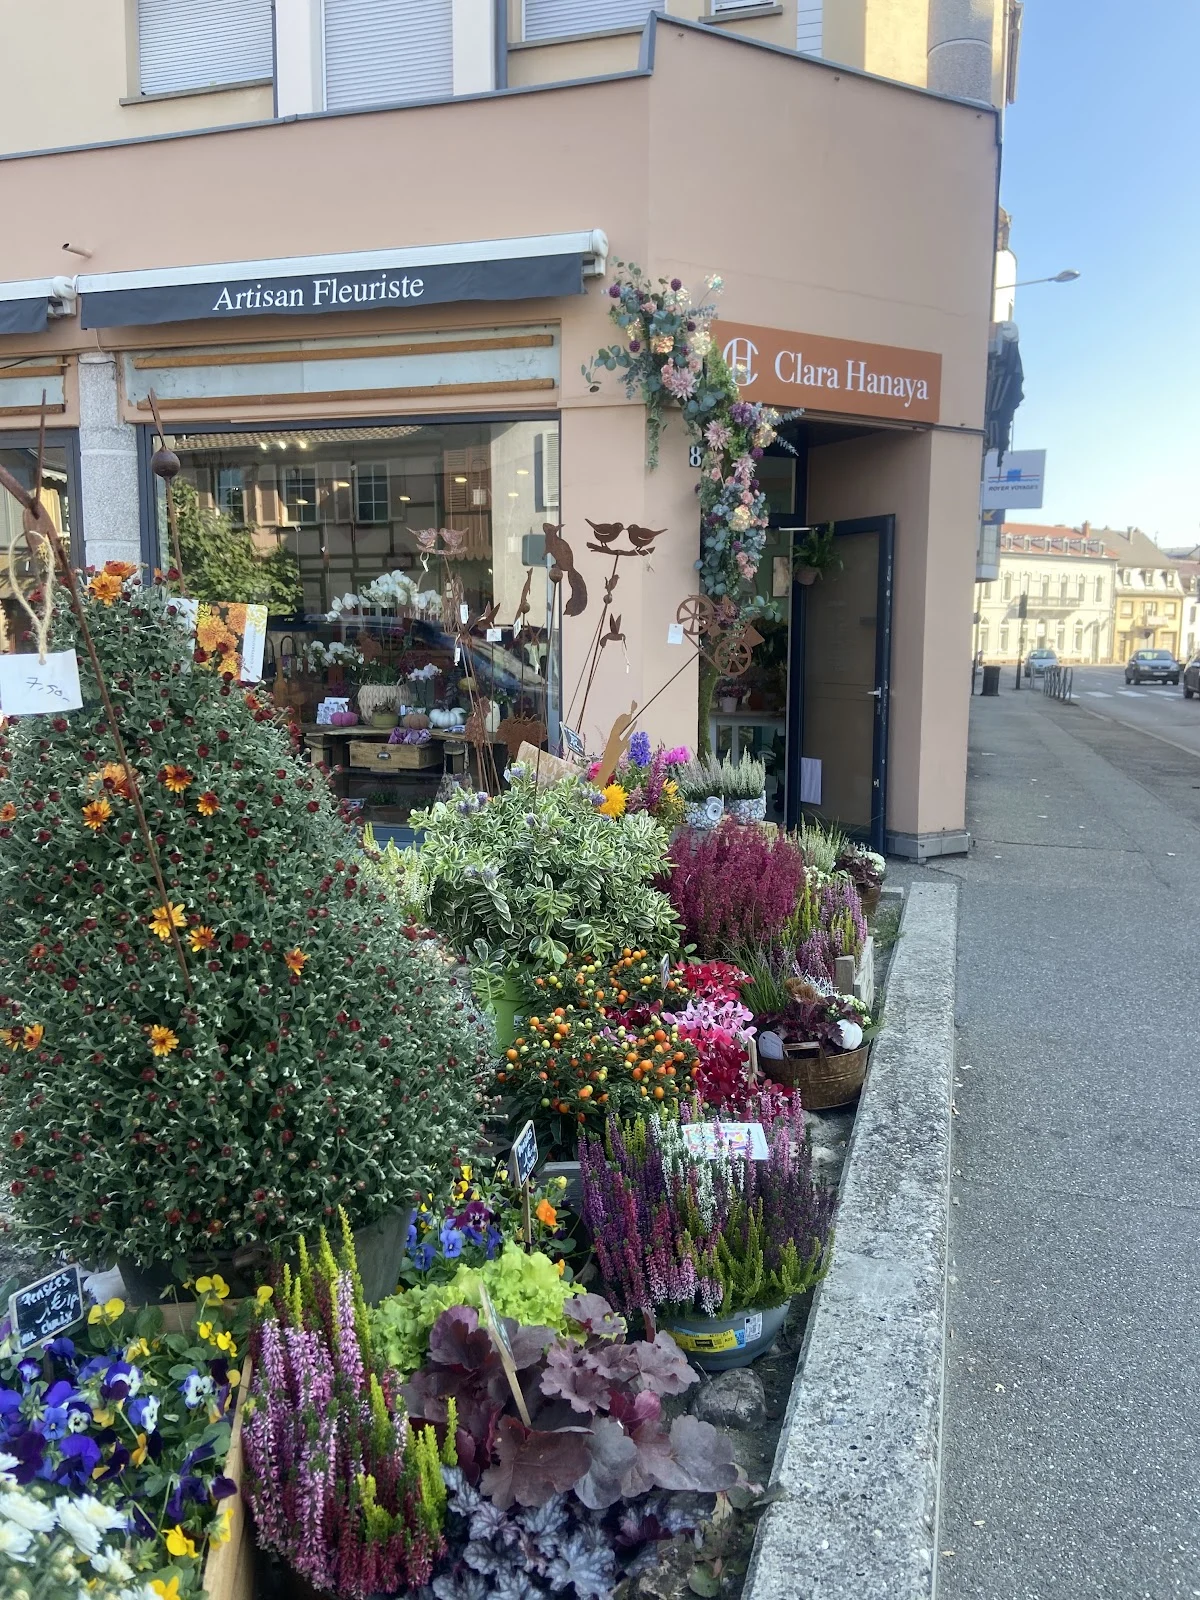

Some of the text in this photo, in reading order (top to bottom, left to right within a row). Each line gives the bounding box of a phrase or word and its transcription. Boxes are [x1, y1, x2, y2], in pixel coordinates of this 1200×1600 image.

[212, 273, 425, 311] Artisan Fleuriste
[774, 350, 930, 408] Clara Hanaya
[690, 446, 702, 467] 8
